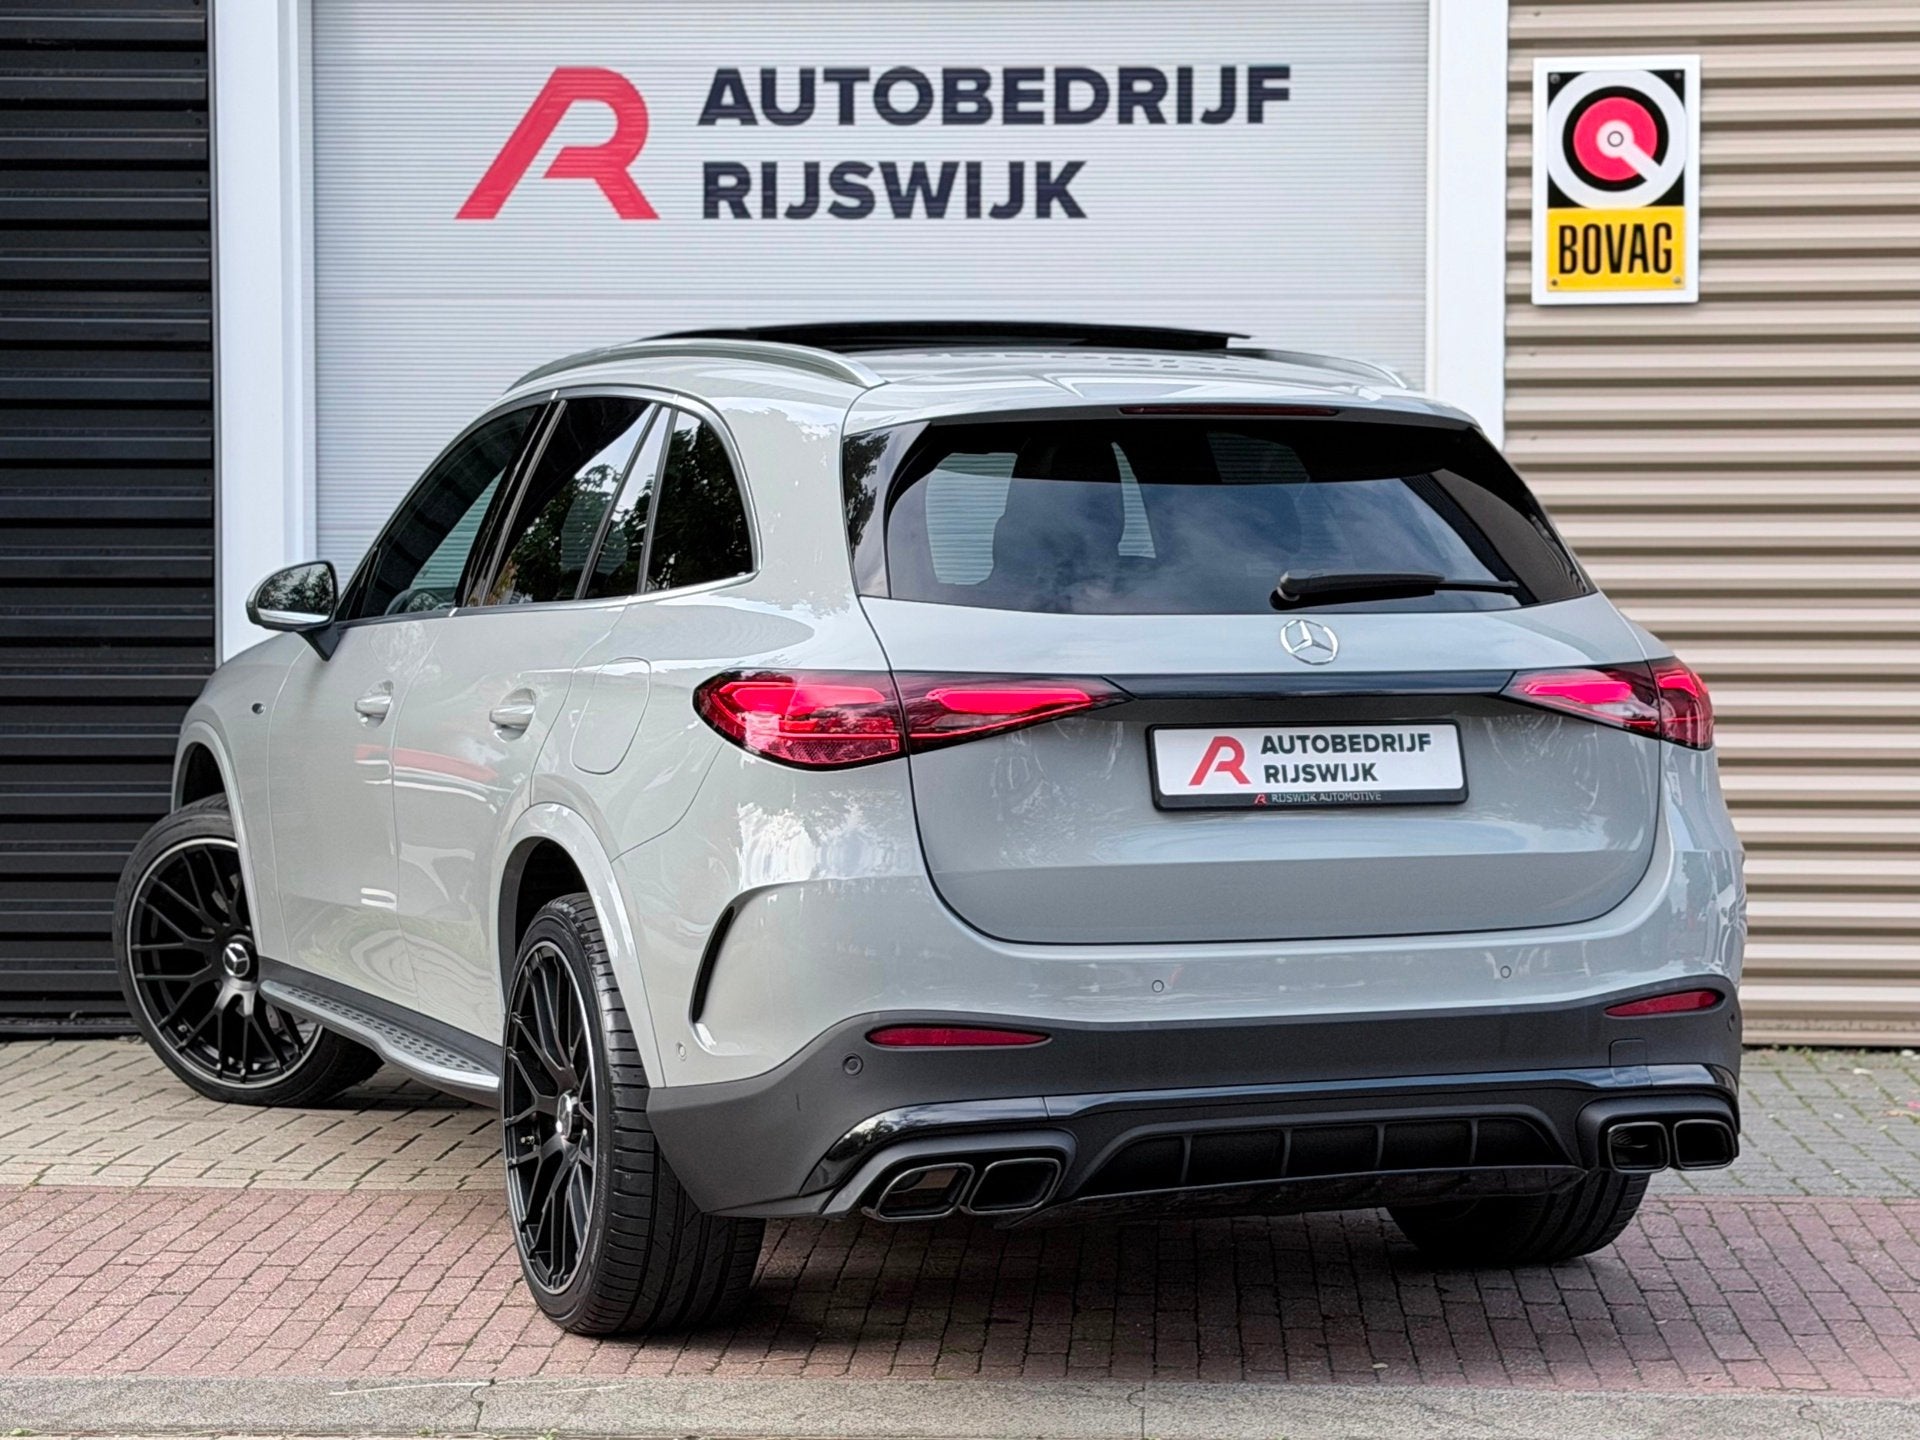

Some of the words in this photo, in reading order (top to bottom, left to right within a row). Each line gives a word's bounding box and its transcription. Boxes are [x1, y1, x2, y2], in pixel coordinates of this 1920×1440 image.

[698, 65, 1291, 126] AUTOBEDRIJF
[702, 160, 1088, 219] RIJSWIJK
[1559, 222, 1673, 275] BOVAG
[1260, 733, 1432, 754] AUTOBEDRIJF
[1264, 763, 1378, 783] RIJSWIJK
[1319, 791, 1382, 802] AUTOMOTIVE
